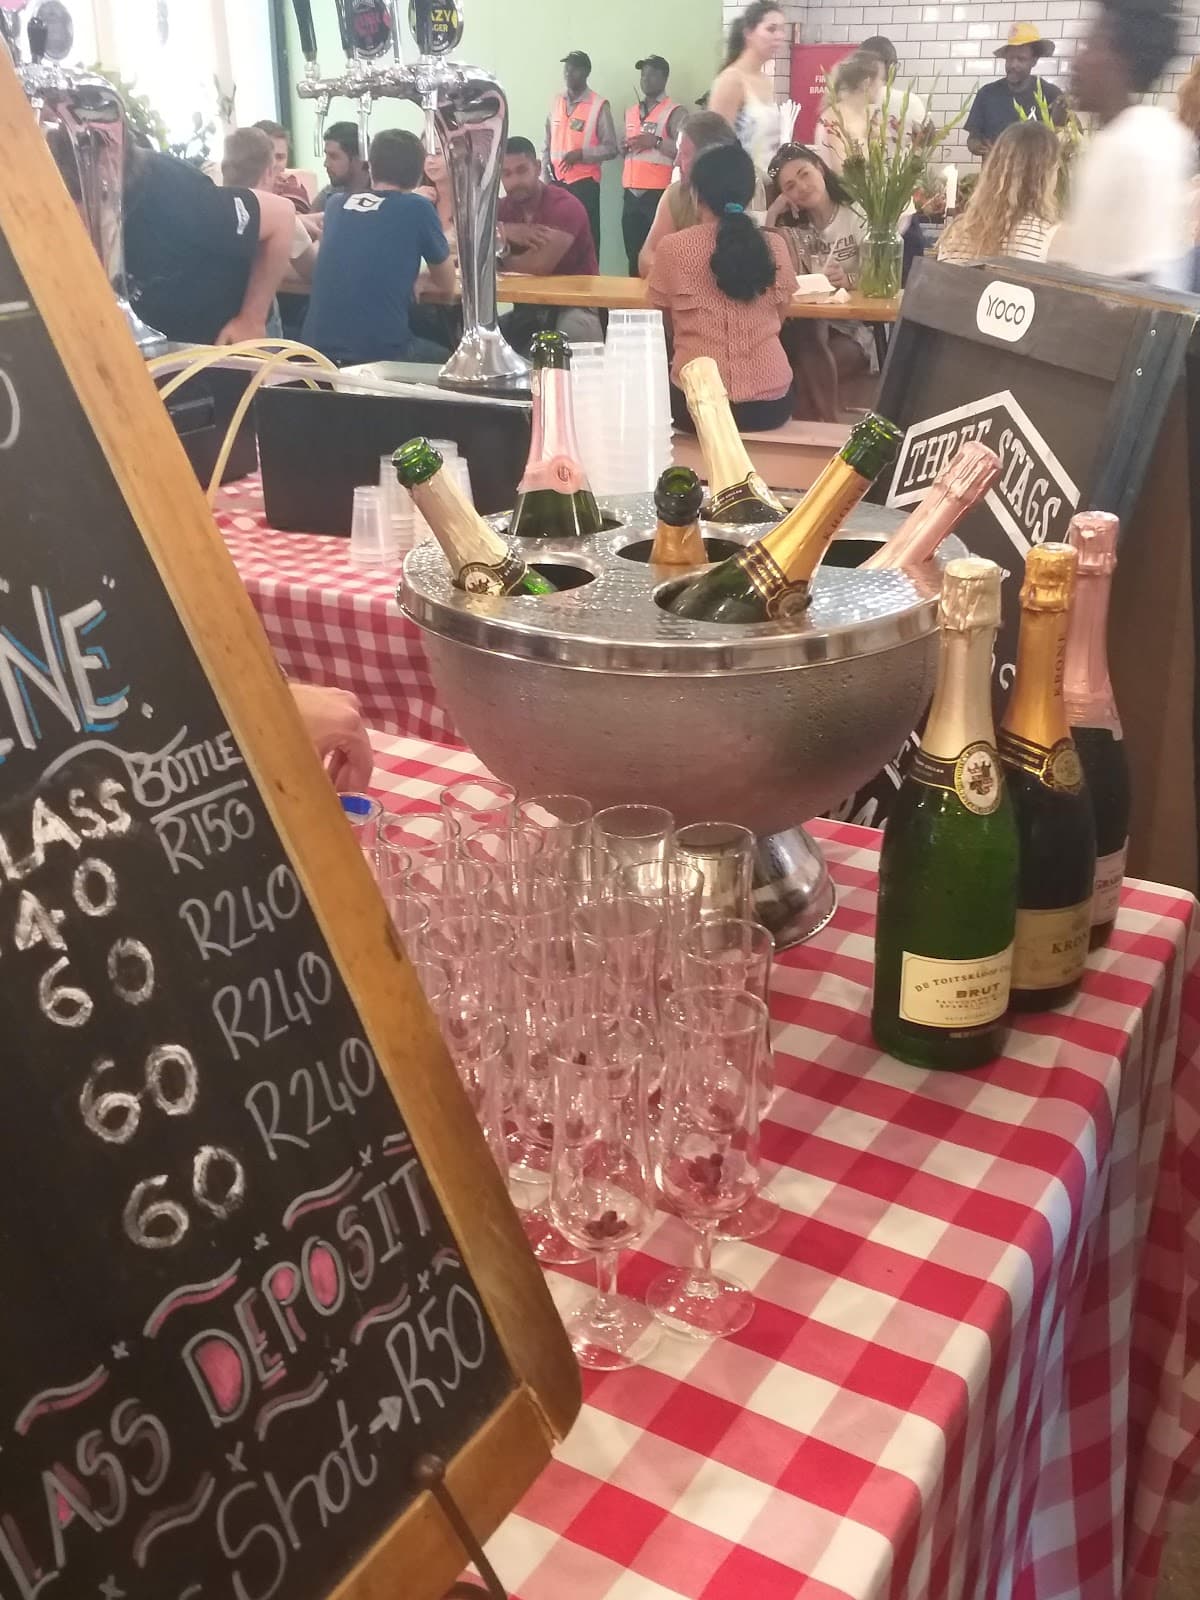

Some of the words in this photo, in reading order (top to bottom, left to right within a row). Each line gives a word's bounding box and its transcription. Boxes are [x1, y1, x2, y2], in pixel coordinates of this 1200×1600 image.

[998, 427, 1062, 544] STAGS
[0, 584, 130, 762] NE
[124, 730, 244, 808] BOTTLE
[155, 798, 255, 874] R150
[39, 938, 155, 1028] 60
[179, 864, 301, 961] R240
[956, 982, 1001, 999] BRUT
[80, 1044, 198, 1144] 60
[212, 951, 332, 1061] R240
[122, 1144, 246, 1249] 60
[244, 1036, 376, 1161] R240
[181, 1158, 432, 1429] DEPOSIT
[216, 1399, 379, 1600] Shot
[386, 1284, 487, 1425] R50
